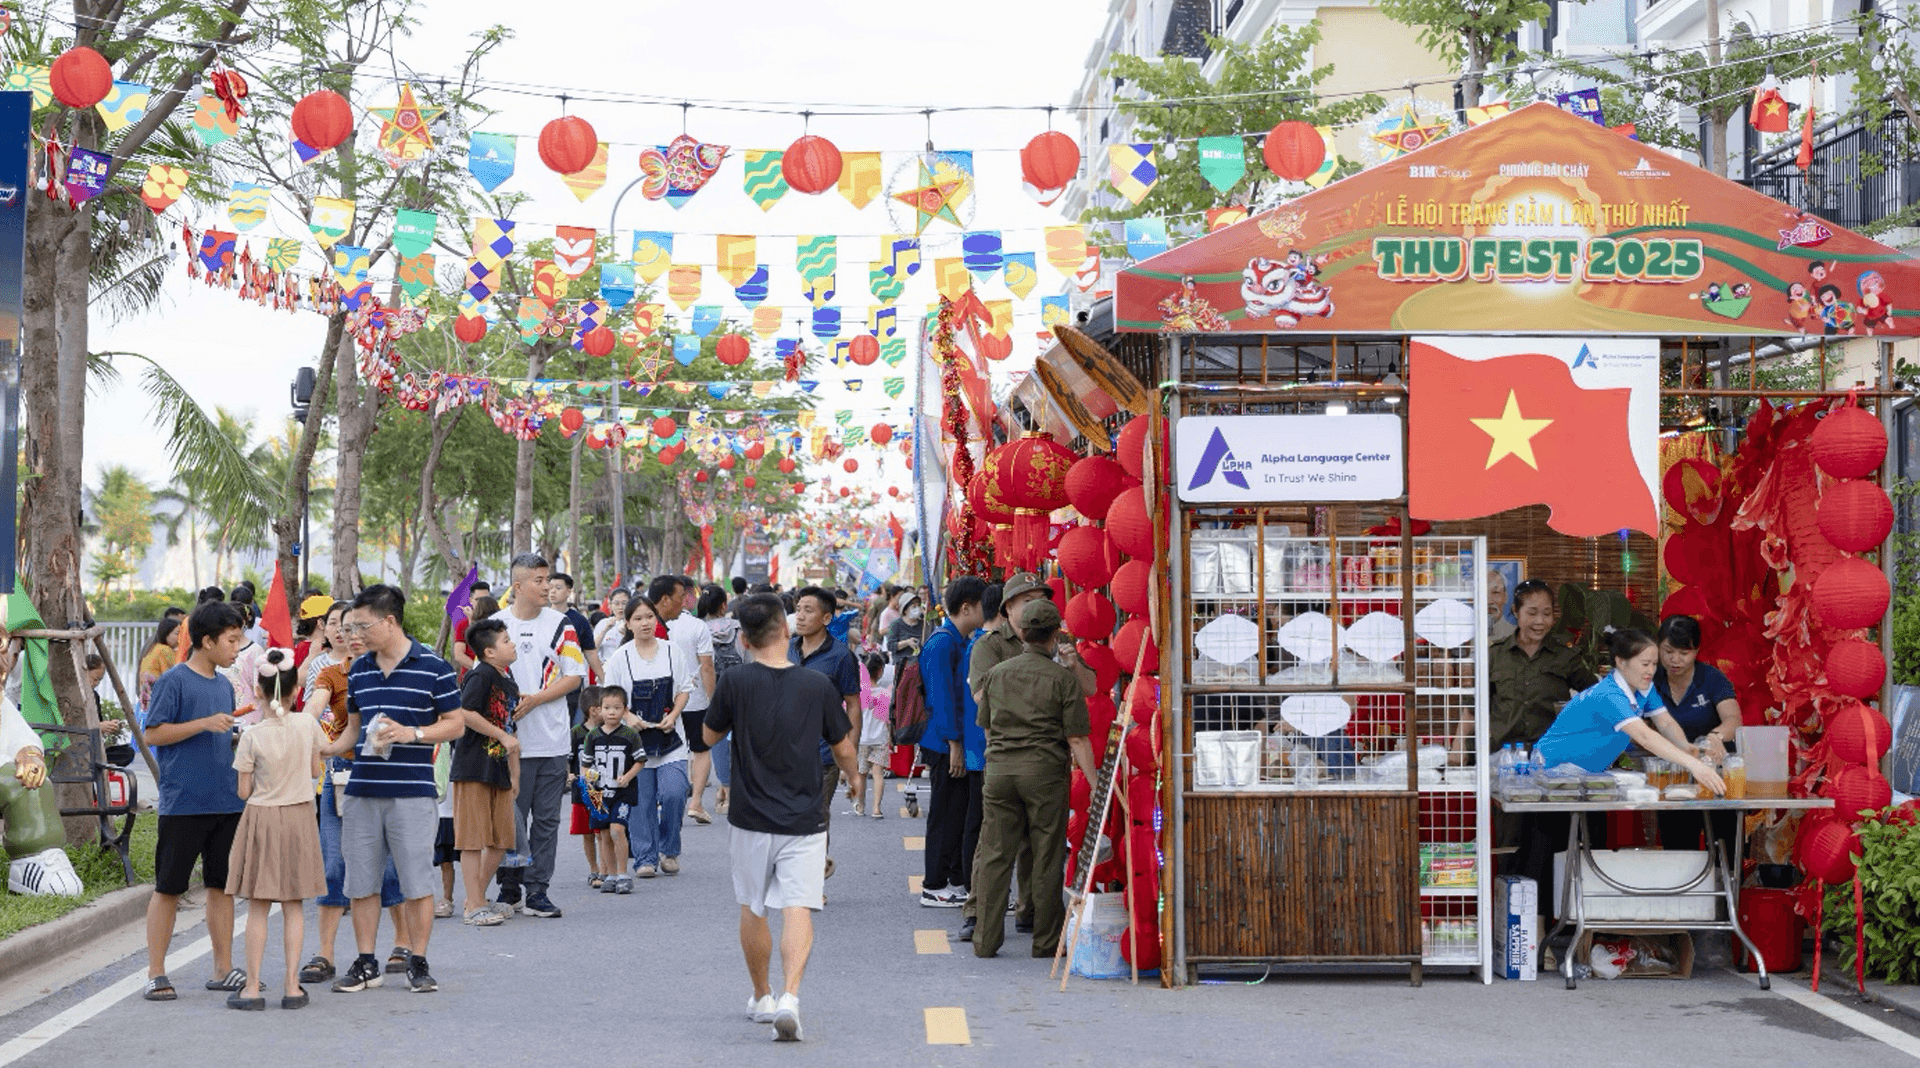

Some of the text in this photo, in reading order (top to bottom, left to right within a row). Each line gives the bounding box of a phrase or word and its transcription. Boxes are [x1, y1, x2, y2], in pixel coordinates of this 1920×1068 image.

[1409, 165, 1473, 180] BIMGroup
[1562, 161, 1590, 177] CHÁY
[1386, 194, 1691, 232] LỄ HỘI TRĂNG RẰM LẦN THỨ NHẤT
[1373, 237, 1704, 284] THU FEST 2025
[1261, 453, 1391, 465] Alpha Language Center
[1264, 472, 1357, 484] In Trust We Shine
[1511, 924, 1520, 972] SAPPHIRE
